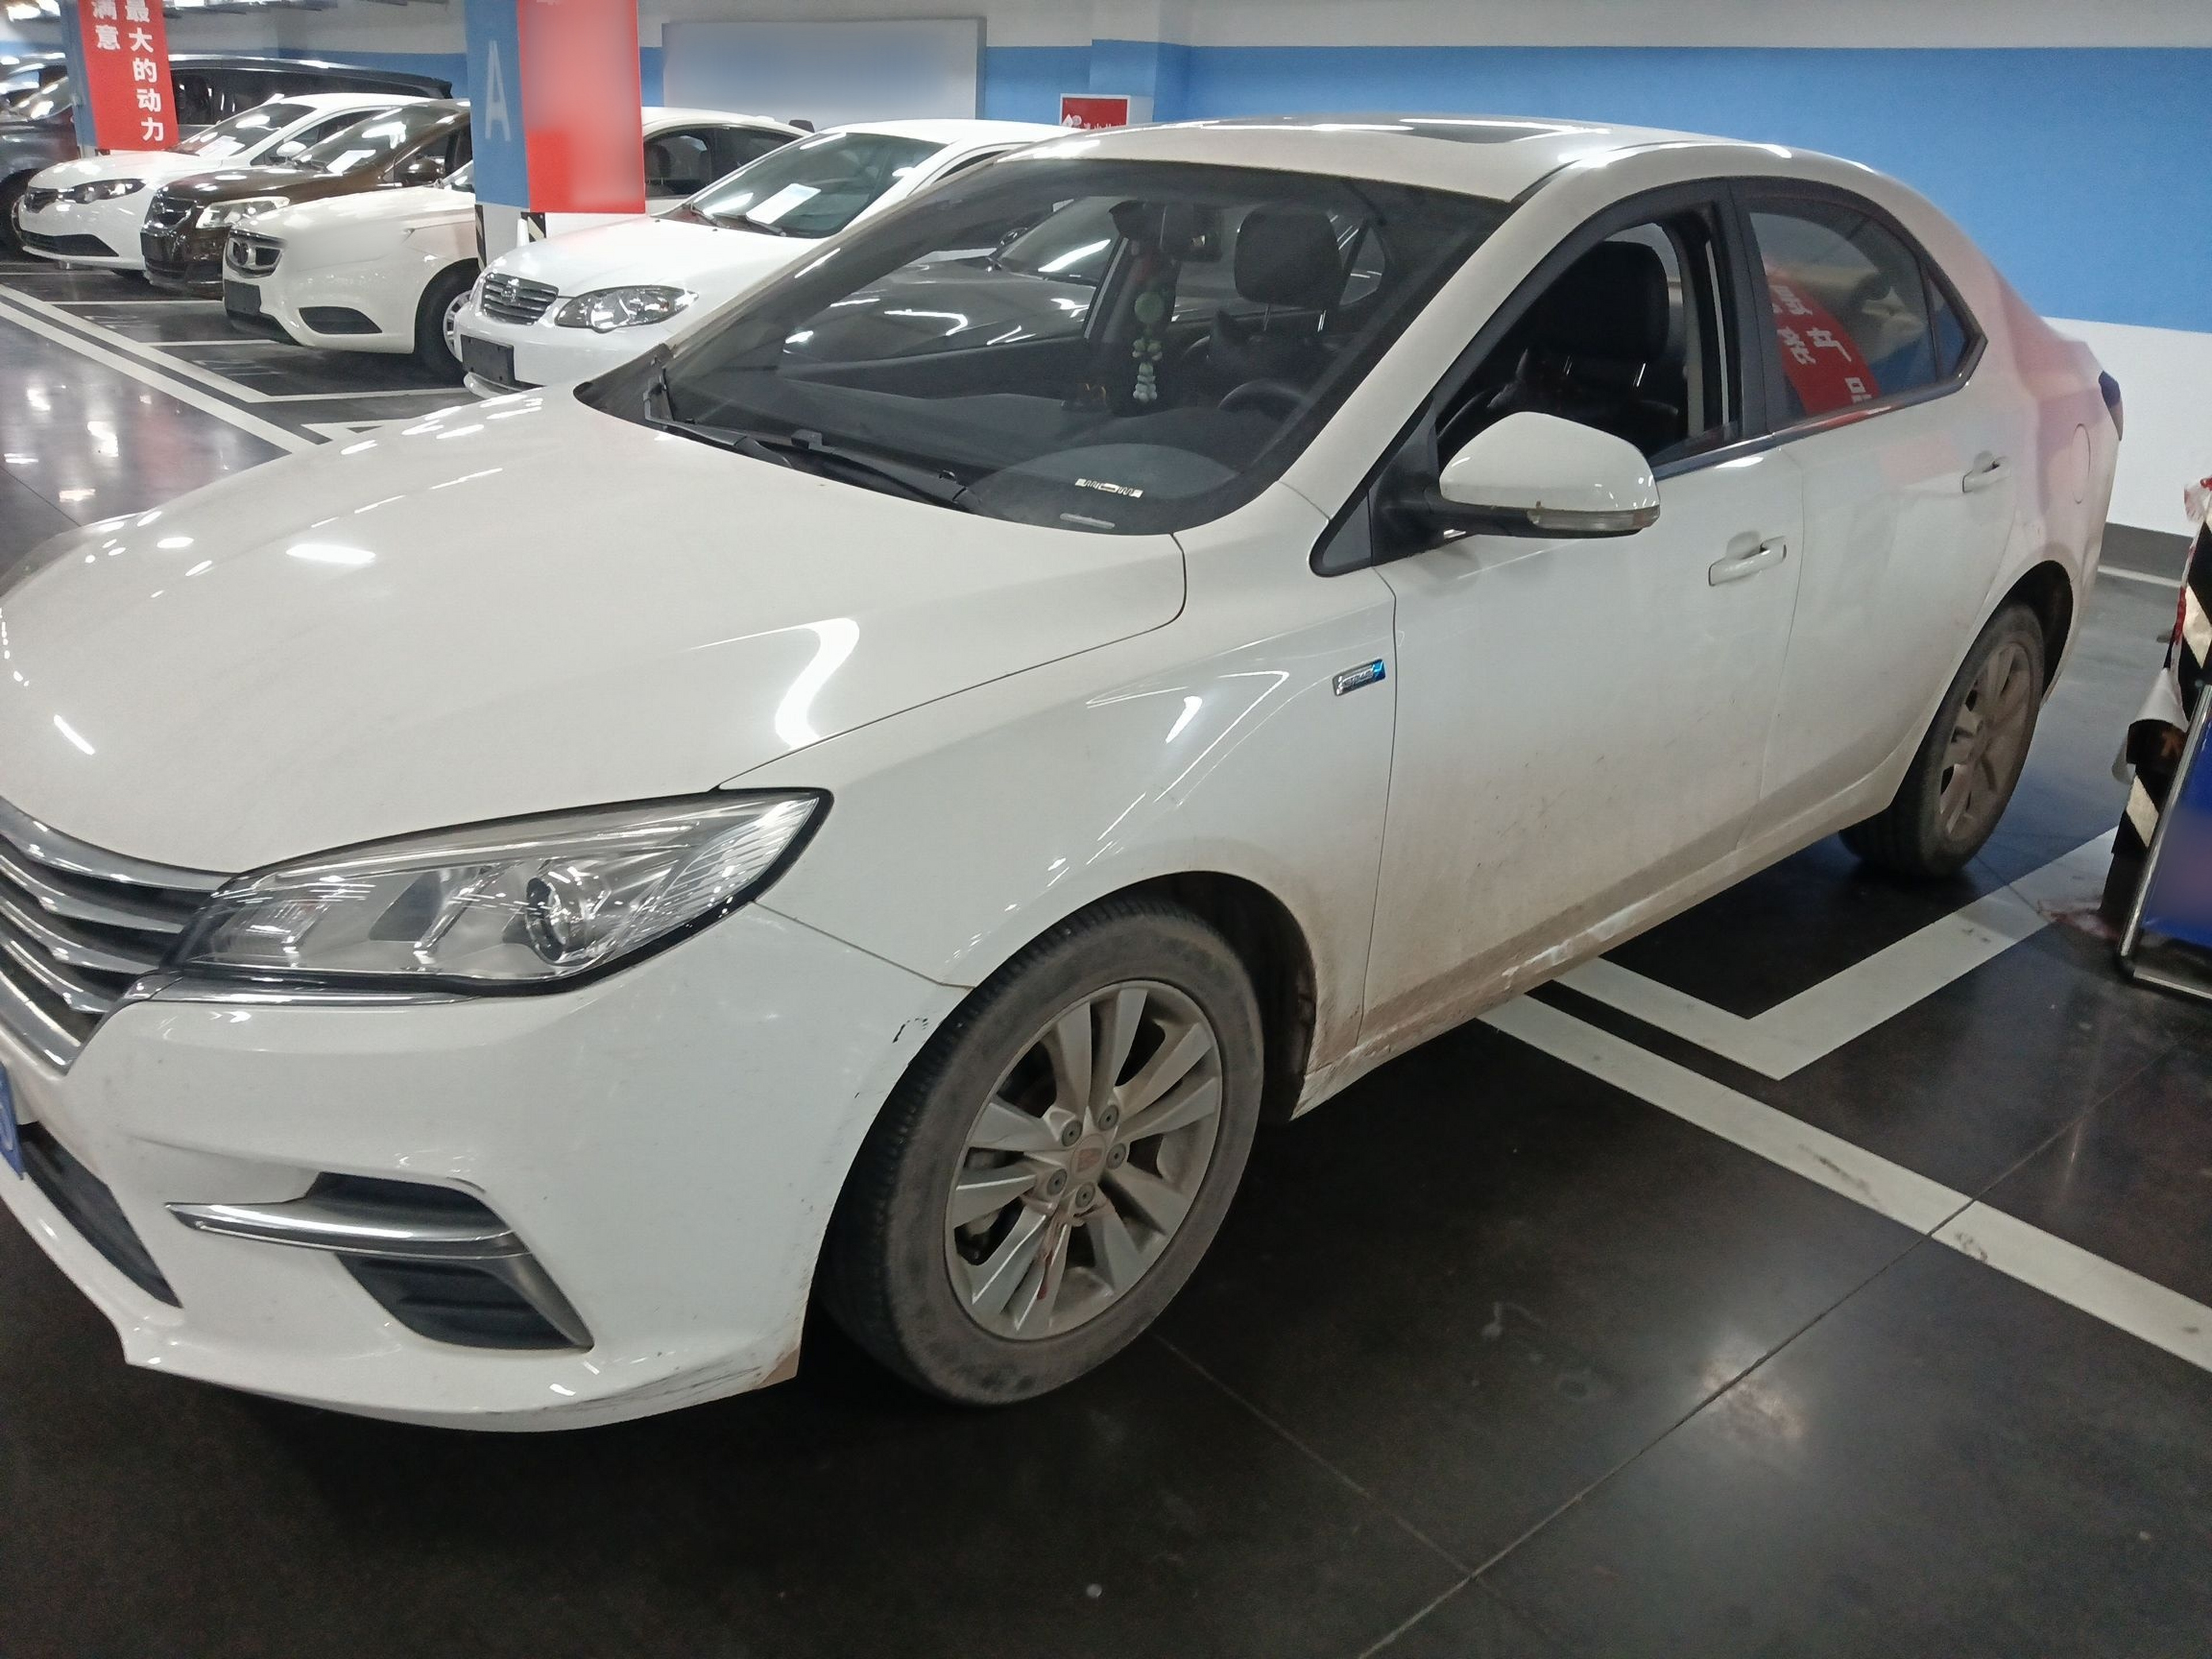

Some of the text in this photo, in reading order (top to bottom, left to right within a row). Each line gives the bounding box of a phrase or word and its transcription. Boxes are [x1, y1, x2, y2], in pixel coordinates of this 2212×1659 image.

[125, 0, 164, 141] 最大的动力
[484, 40, 512, 141] A
